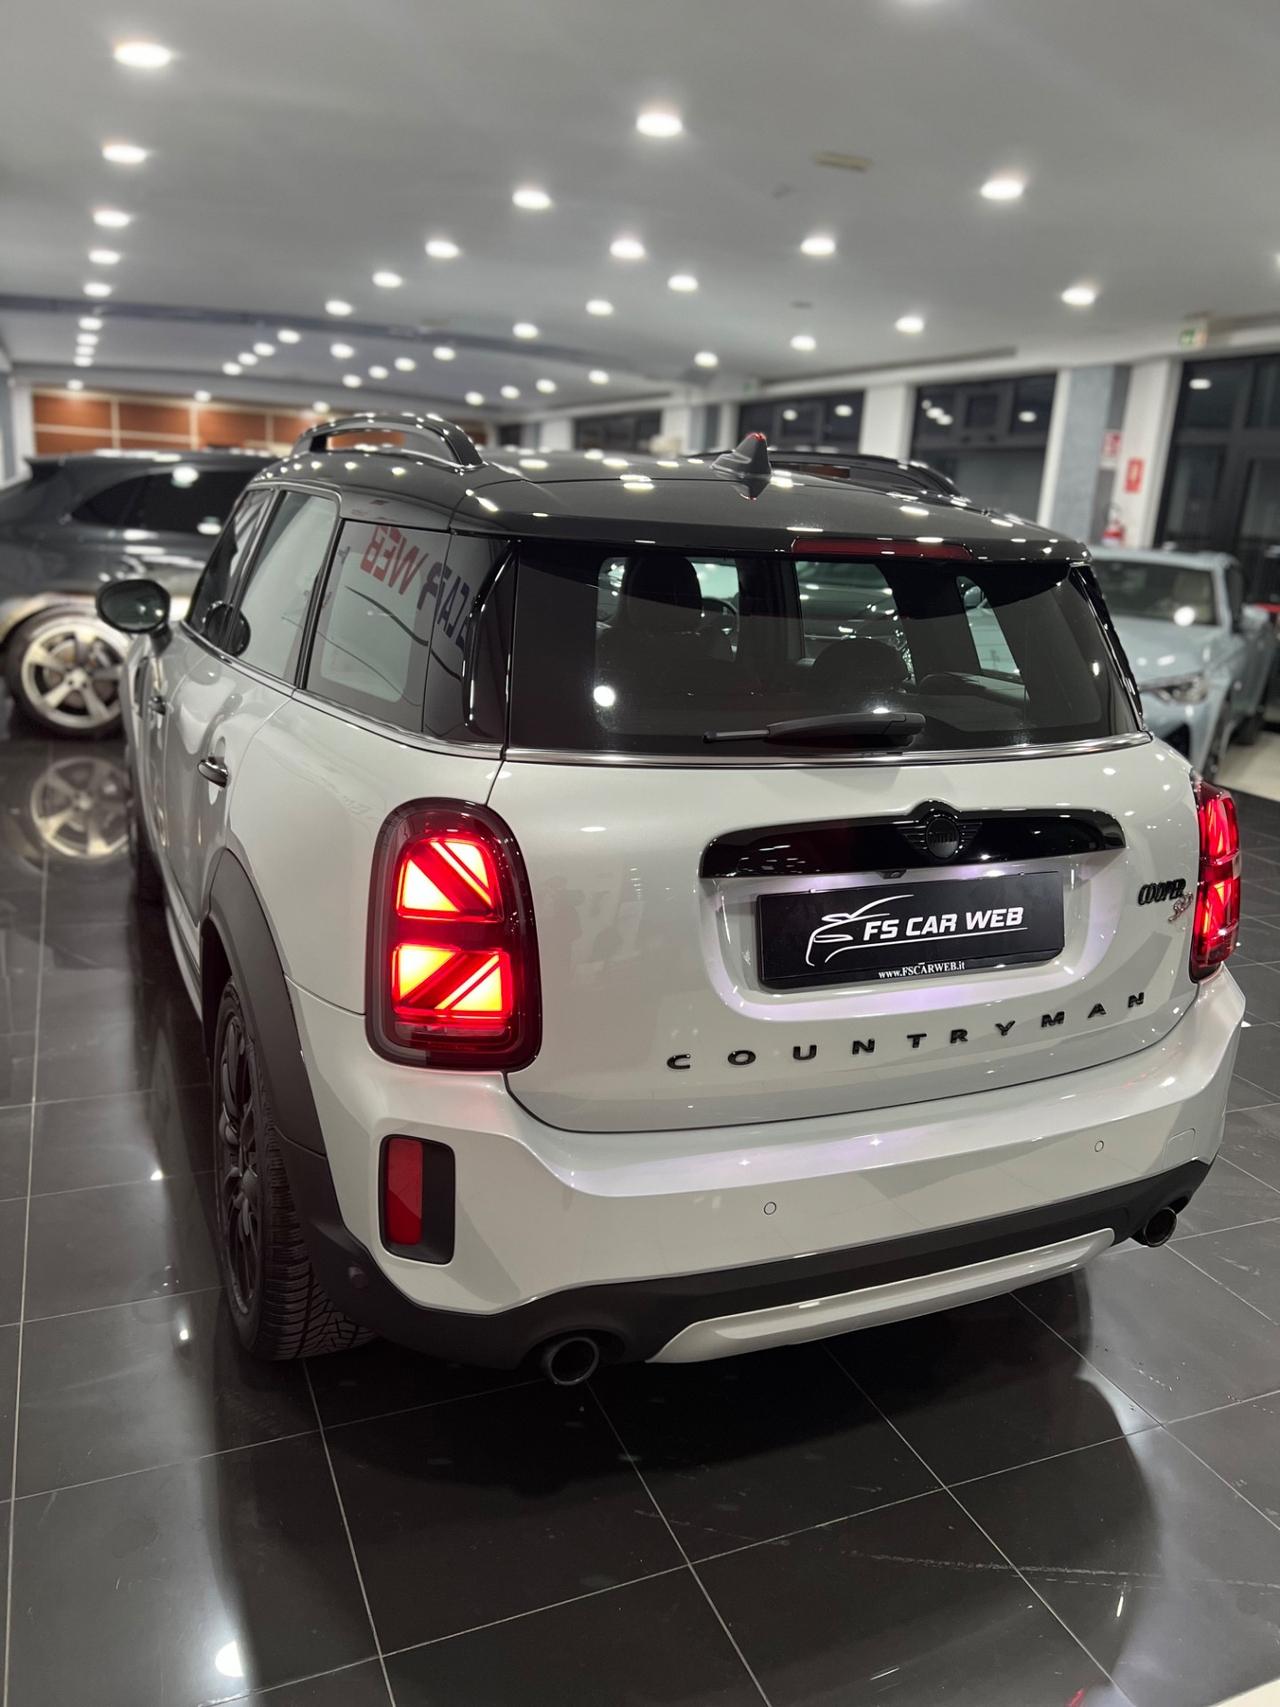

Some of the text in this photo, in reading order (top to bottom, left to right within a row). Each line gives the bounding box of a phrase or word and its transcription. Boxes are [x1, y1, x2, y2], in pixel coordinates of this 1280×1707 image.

[1138, 878, 1186, 905] COOPER
[863, 906, 1025, 941] FS CAR WEB
[666, 991, 1146, 1070] COUNTRYMAN
